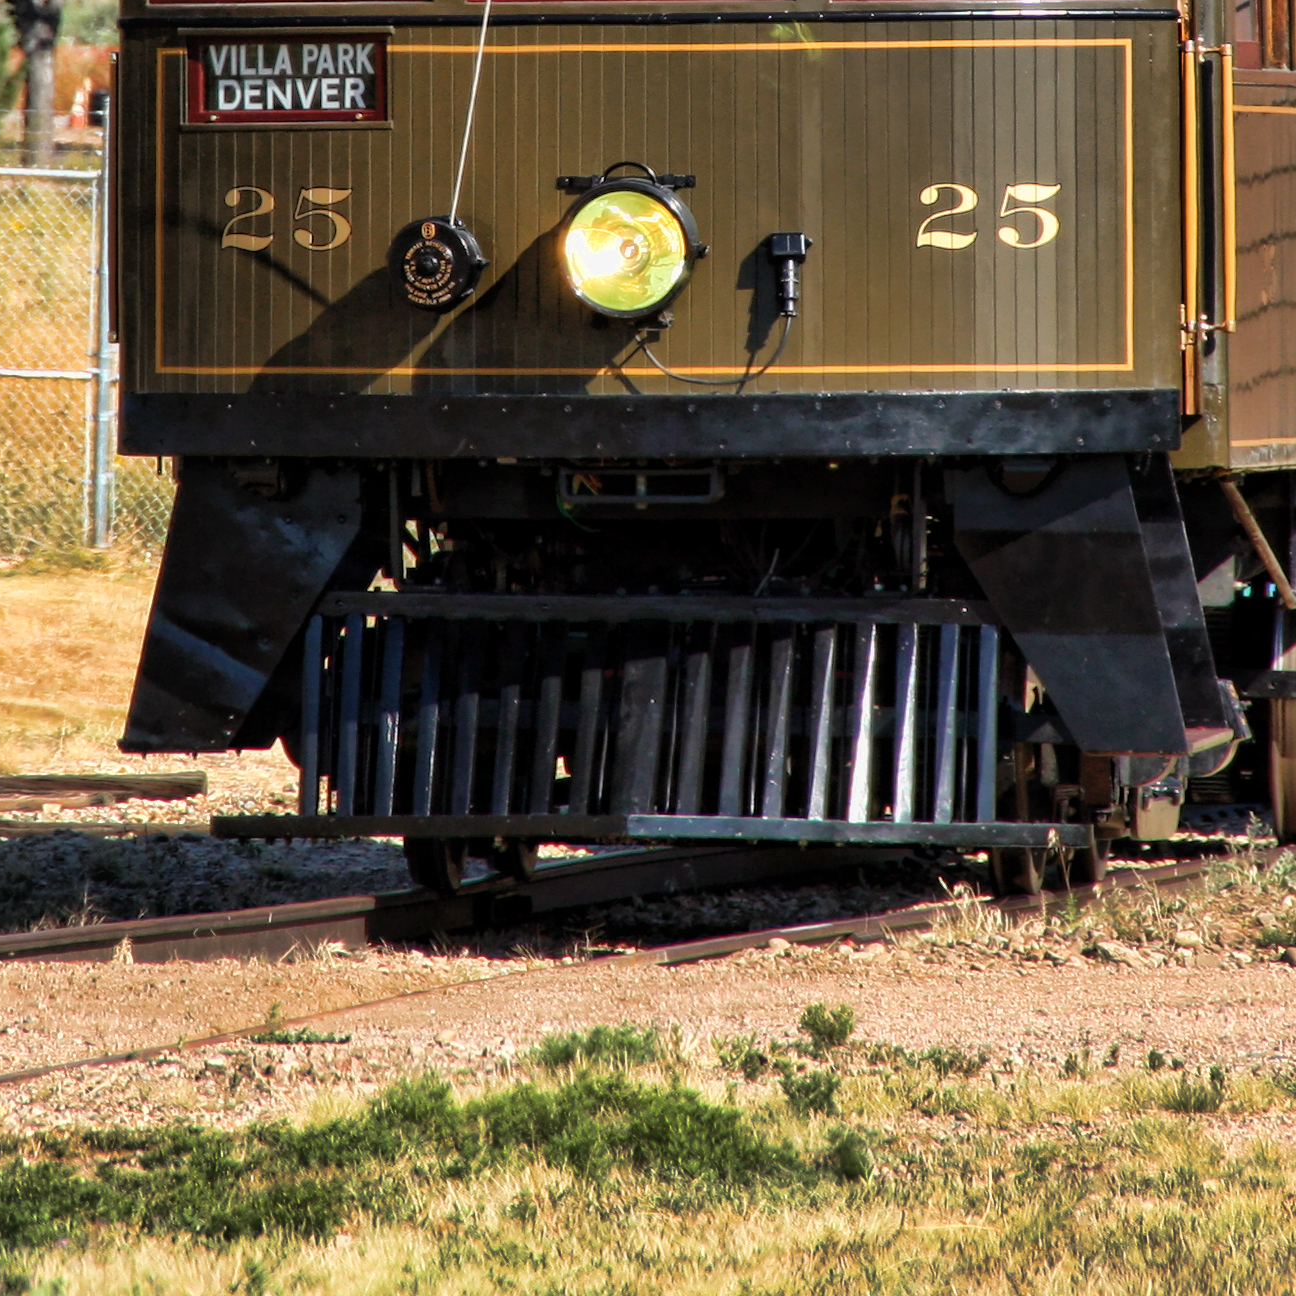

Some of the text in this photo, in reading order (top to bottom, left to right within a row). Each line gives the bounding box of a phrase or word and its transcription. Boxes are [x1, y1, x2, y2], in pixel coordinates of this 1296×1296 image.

[208, 43, 375, 76] VILLA PARK
[217, 77, 367, 111] DENVER
[221, 185, 354, 252] 25
[915, 182, 1062, 250] 25
